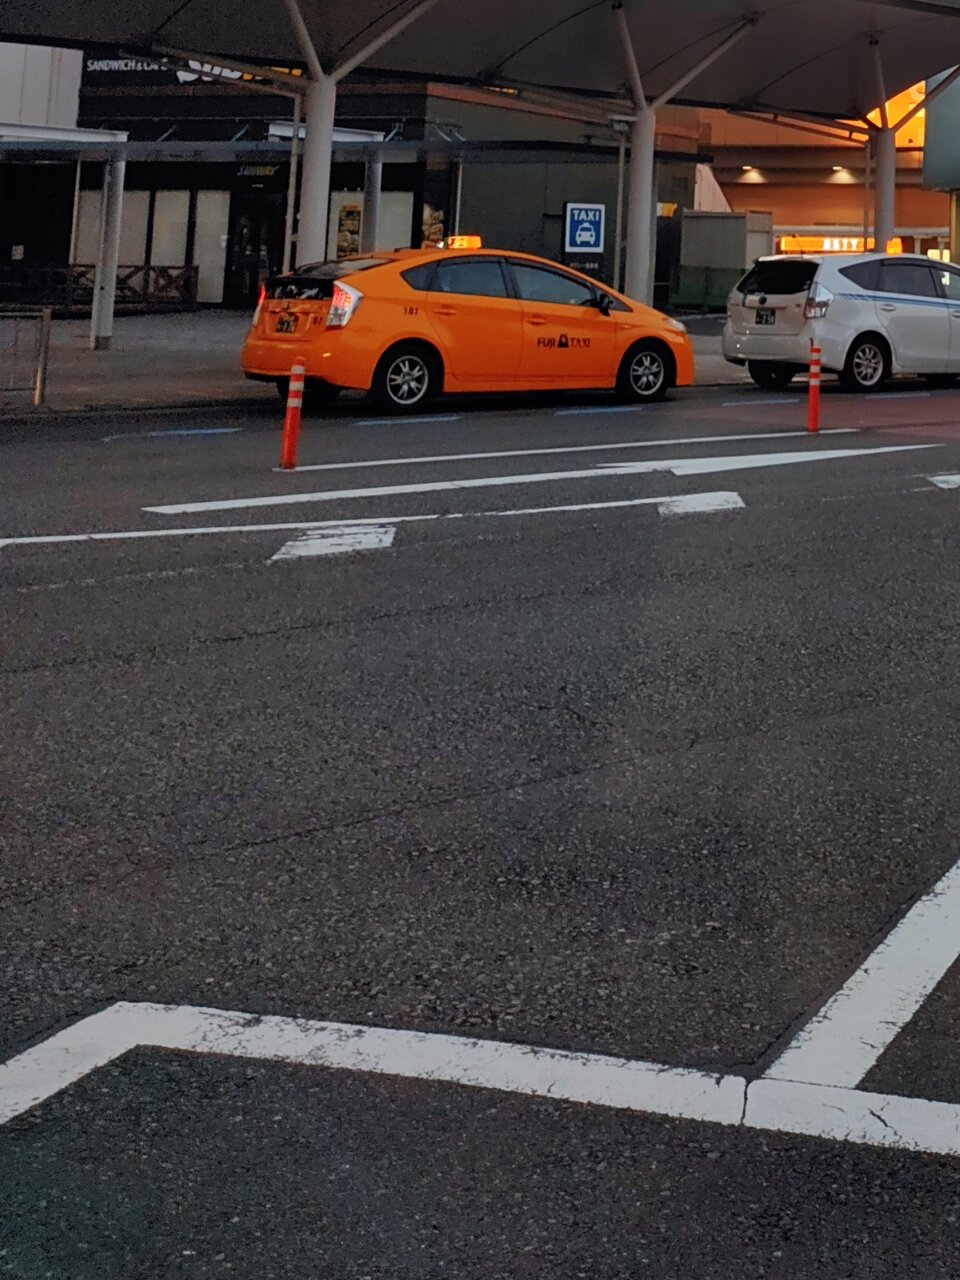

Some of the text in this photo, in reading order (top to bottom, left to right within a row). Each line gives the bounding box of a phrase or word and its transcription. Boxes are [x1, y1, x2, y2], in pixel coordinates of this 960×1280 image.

[87, 59, 136, 71] SANDWICH
[573, 210, 599, 221] TAXI
[537, 337, 591, 349] FUJI TAXI
